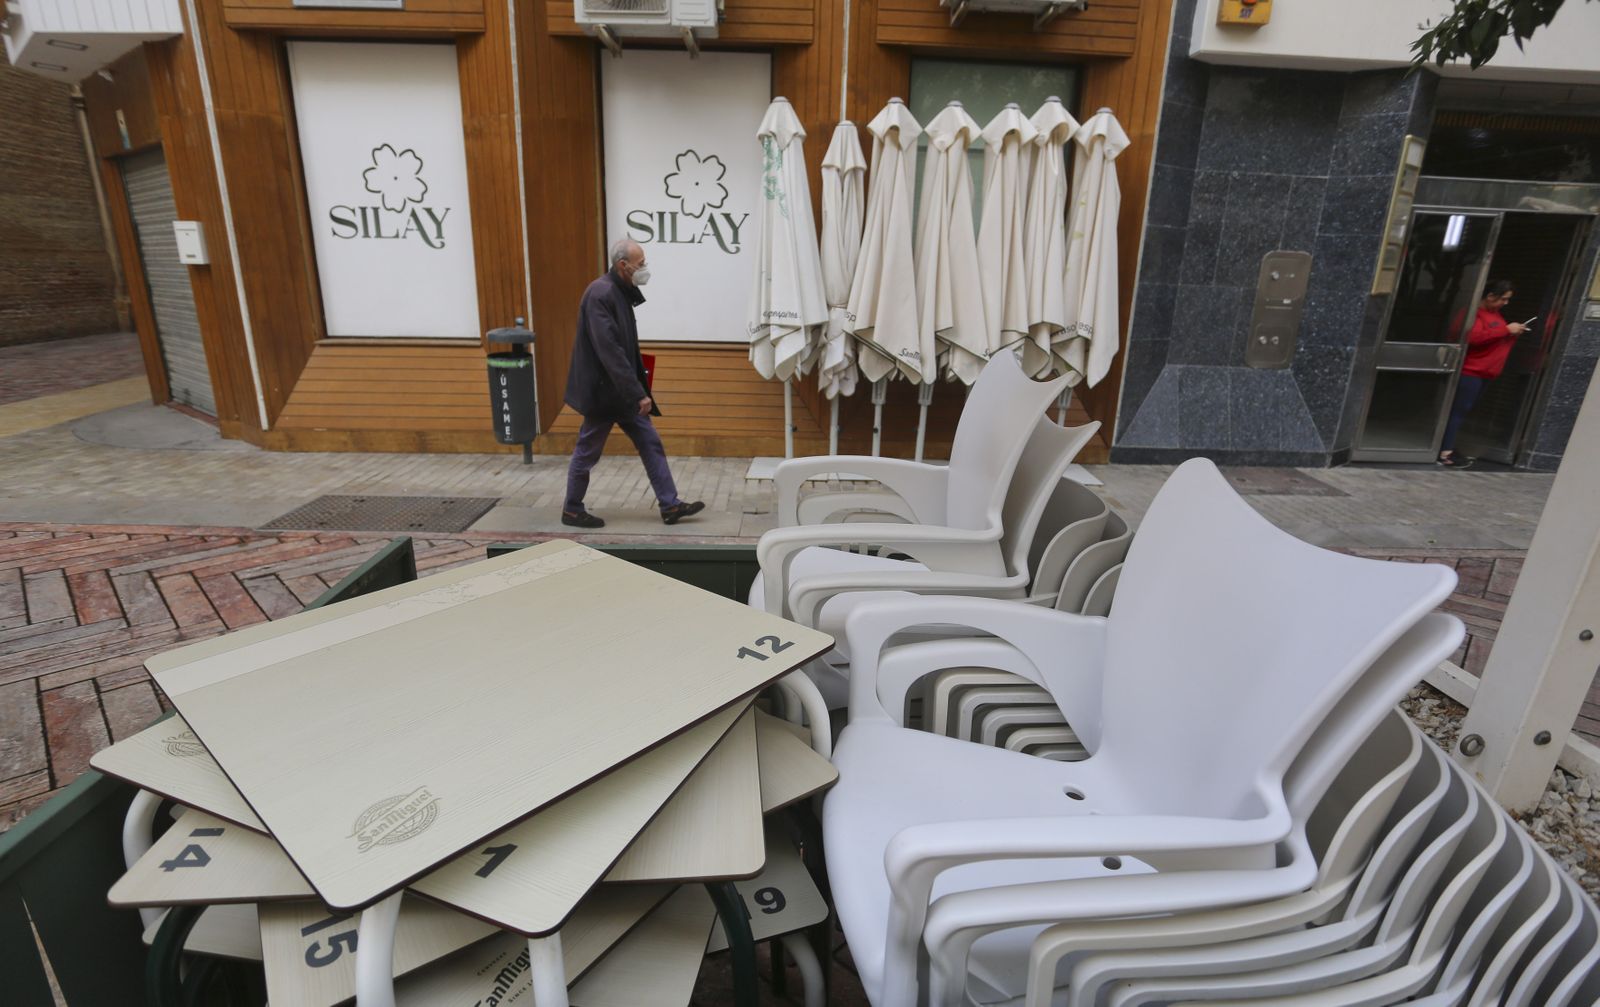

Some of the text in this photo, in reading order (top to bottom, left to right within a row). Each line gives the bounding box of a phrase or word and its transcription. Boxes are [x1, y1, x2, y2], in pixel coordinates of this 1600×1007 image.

[329, 205, 450, 249] SILAY
[626, 209, 749, 254] SILAY
[737, 635, 795, 661] 12
[159, 827, 225, 872] 14
[474, 843, 518, 878] 1
[740, 887, 786, 919] 9
[301, 913, 359, 967] 15
